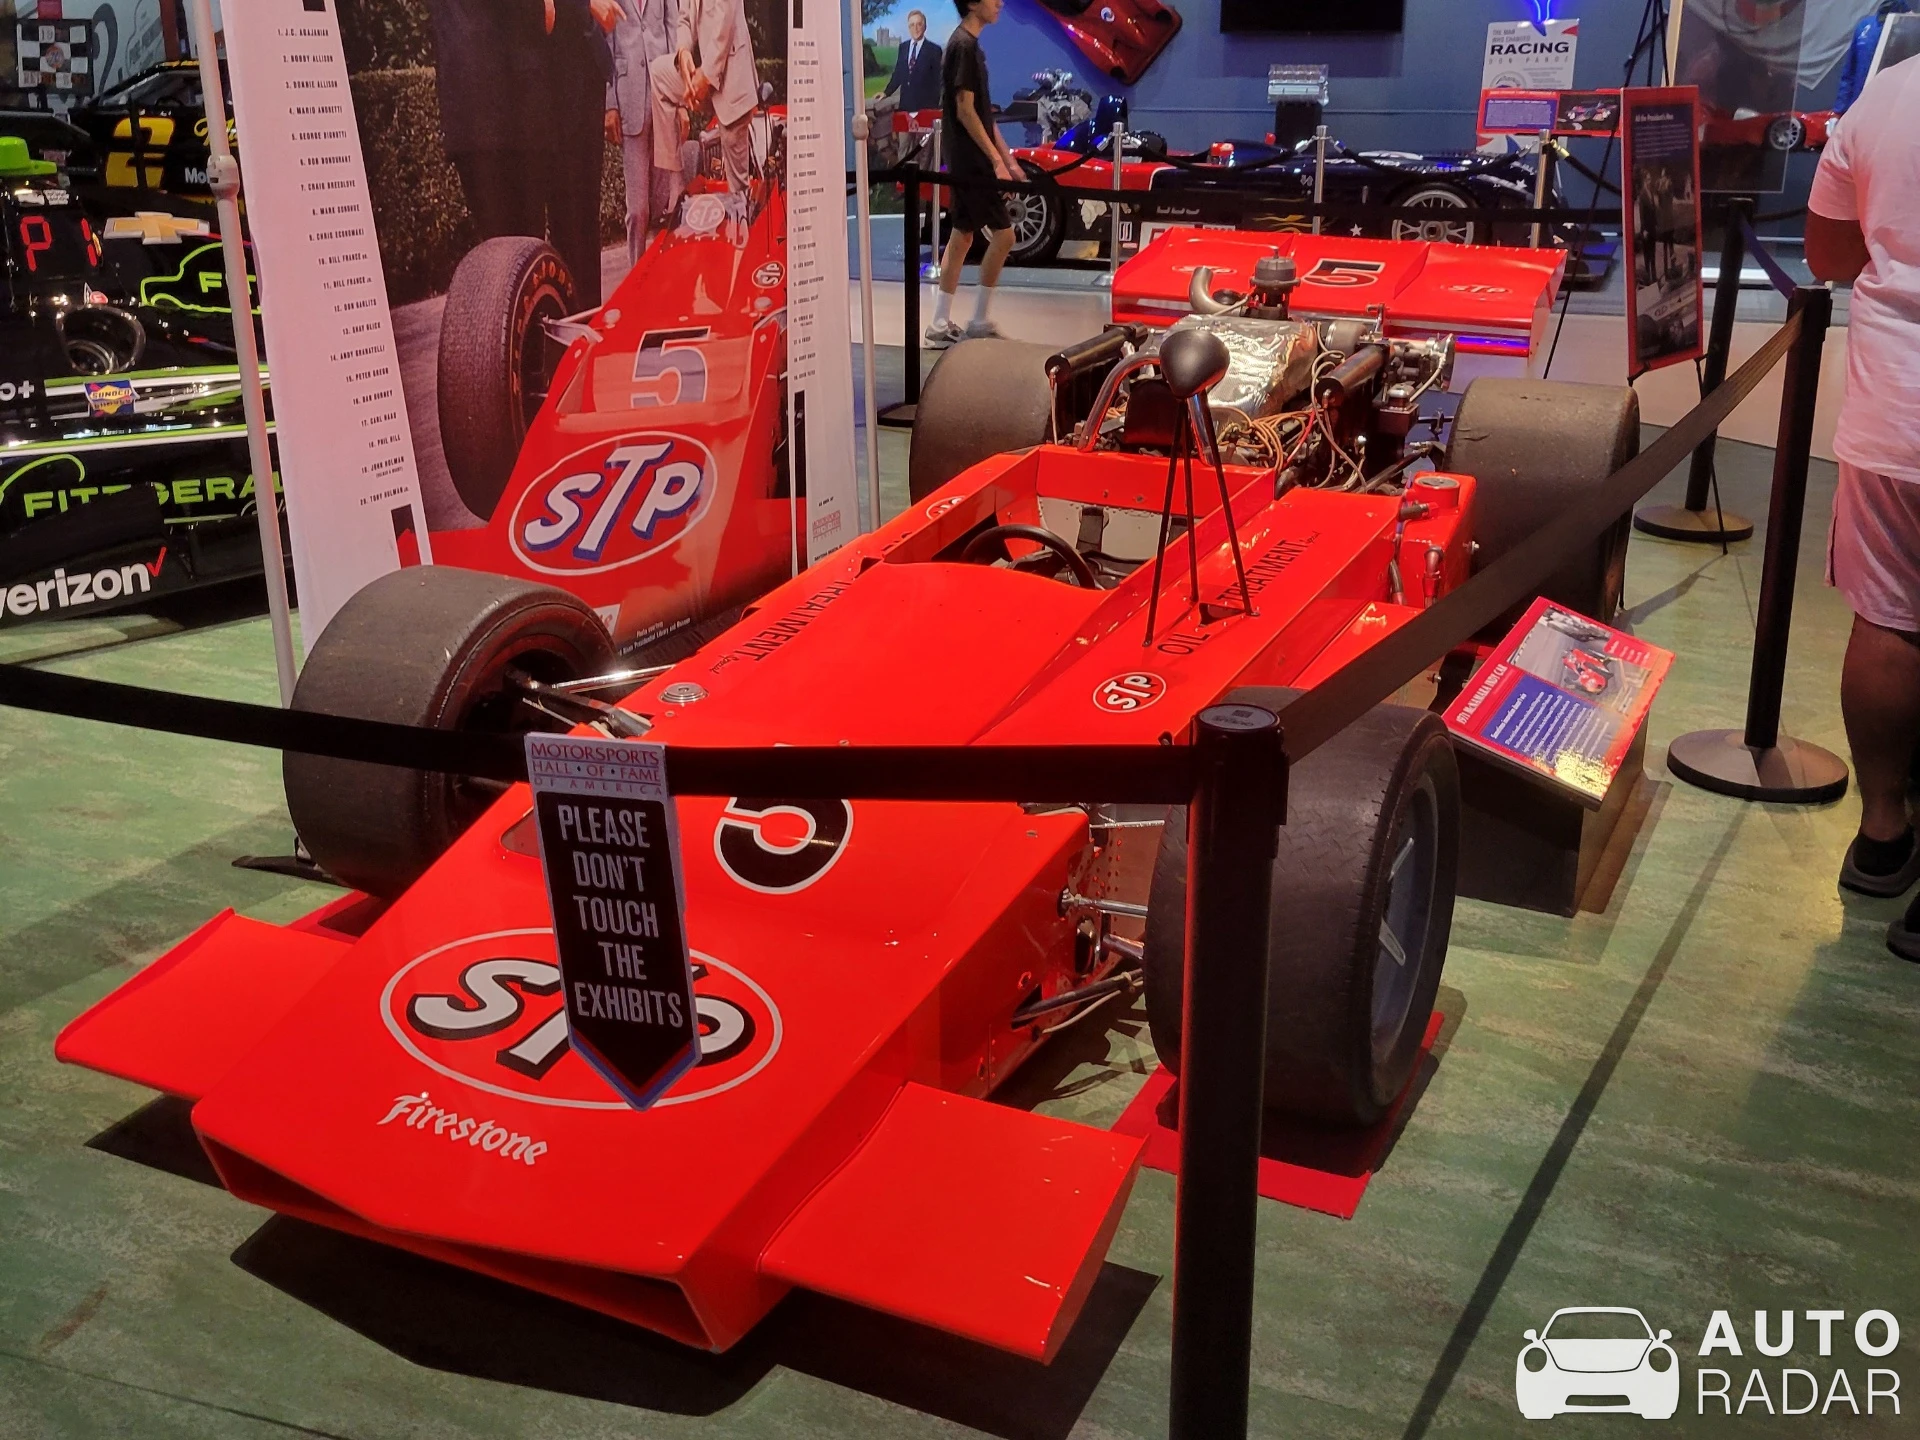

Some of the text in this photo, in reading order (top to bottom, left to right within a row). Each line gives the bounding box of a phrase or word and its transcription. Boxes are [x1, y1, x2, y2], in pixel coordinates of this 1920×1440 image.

[1490, 42, 1569, 55] RACING
[318, 106, 342, 114] ANDRETTI
[687, 200, 723, 224] STP
[343, 253, 361, 262] FRANCE
[347, 276, 365, 286] FRANCE
[759, 262, 783, 287] STP
[1303, 257, 1385, 287] 5
[340, 351, 353, 360] ANDY
[631, 325, 712, 408] 5
[356, 372, 371, 381] PETER
[92, 389, 131, 399] SUNOCO
[370, 417, 382, 425] CARL
[378, 438, 388, 446] PHIL
[523, 441, 704, 561] STP
[1157, 632, 1212, 655] OIL
[1217, 539, 1307, 606] TREATMENT
[634, 633, 655, 648] Presidential
[657, 628, 668, 638] Library
[1102, 675, 1153, 710] STP
[531, 742, 660, 765] MOTORSPORTS
[533, 760, 661, 782] HALL OF FAME
[569, 779, 662, 796] AMERICA
[558, 804, 651, 849] PLEASE
[714, 796, 854, 895] 5
[573, 851, 645, 892] DON'T
[573, 895, 659, 938] TOUCH
[598, 941, 647, 980] THE
[574, 982, 684, 1028] EXHIBITS
[376, 1091, 548, 1166] Firestone
